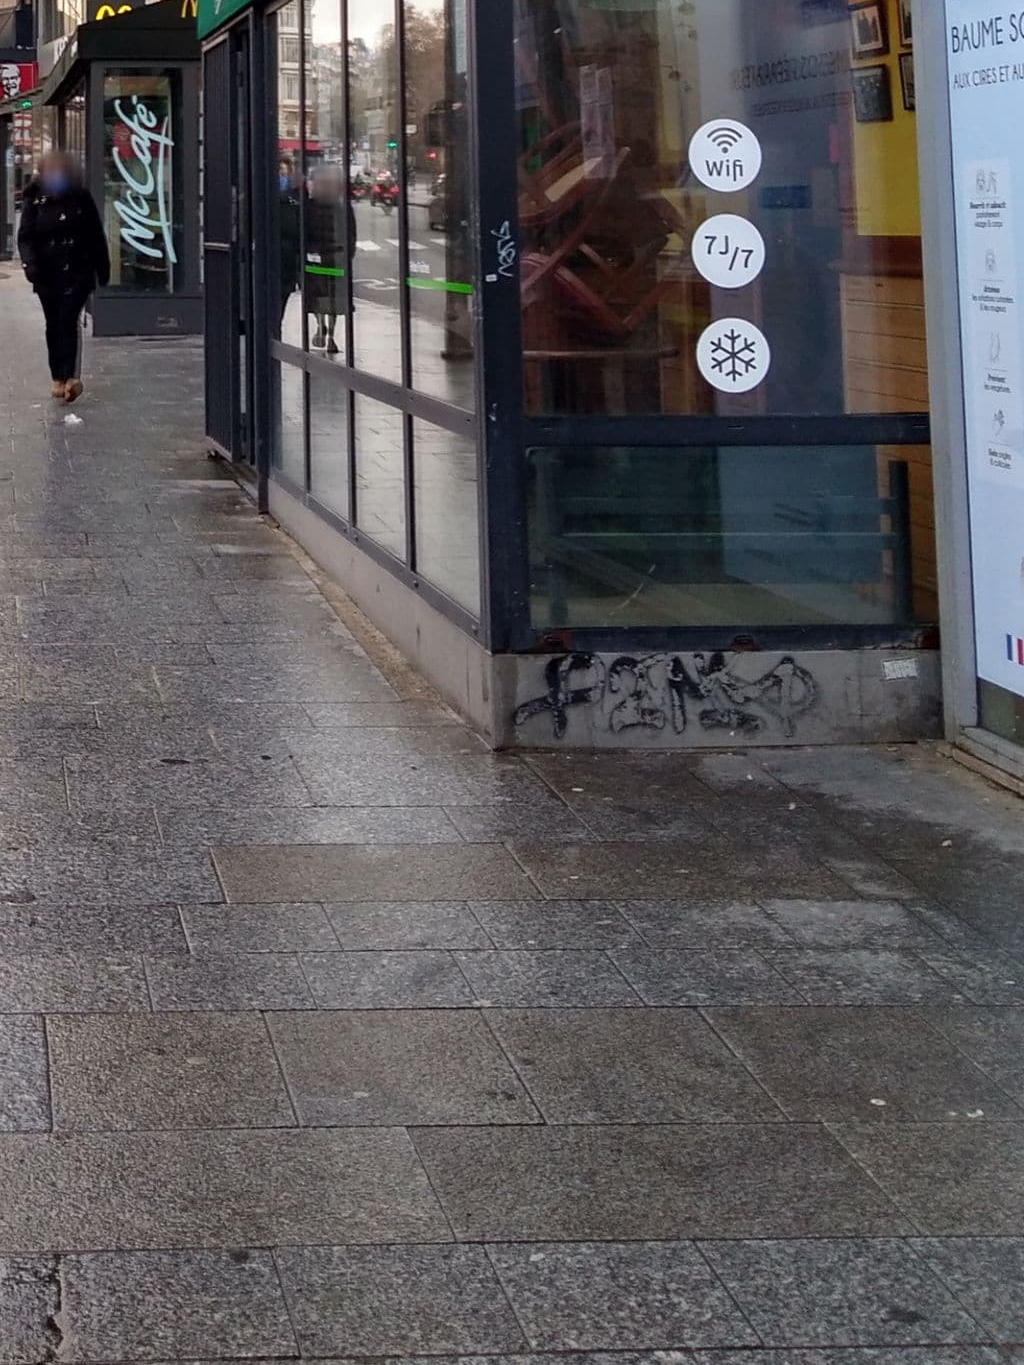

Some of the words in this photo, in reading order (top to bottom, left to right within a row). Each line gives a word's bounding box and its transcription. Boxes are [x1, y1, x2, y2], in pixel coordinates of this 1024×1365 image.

[951, 16, 1003, 54] BAUME
[953, 71, 971, 90] AUX
[1000, 64, 1011, 83] ET
[112, 94, 176, 261] McCafé
[705, 159, 743, 182] Wifi
